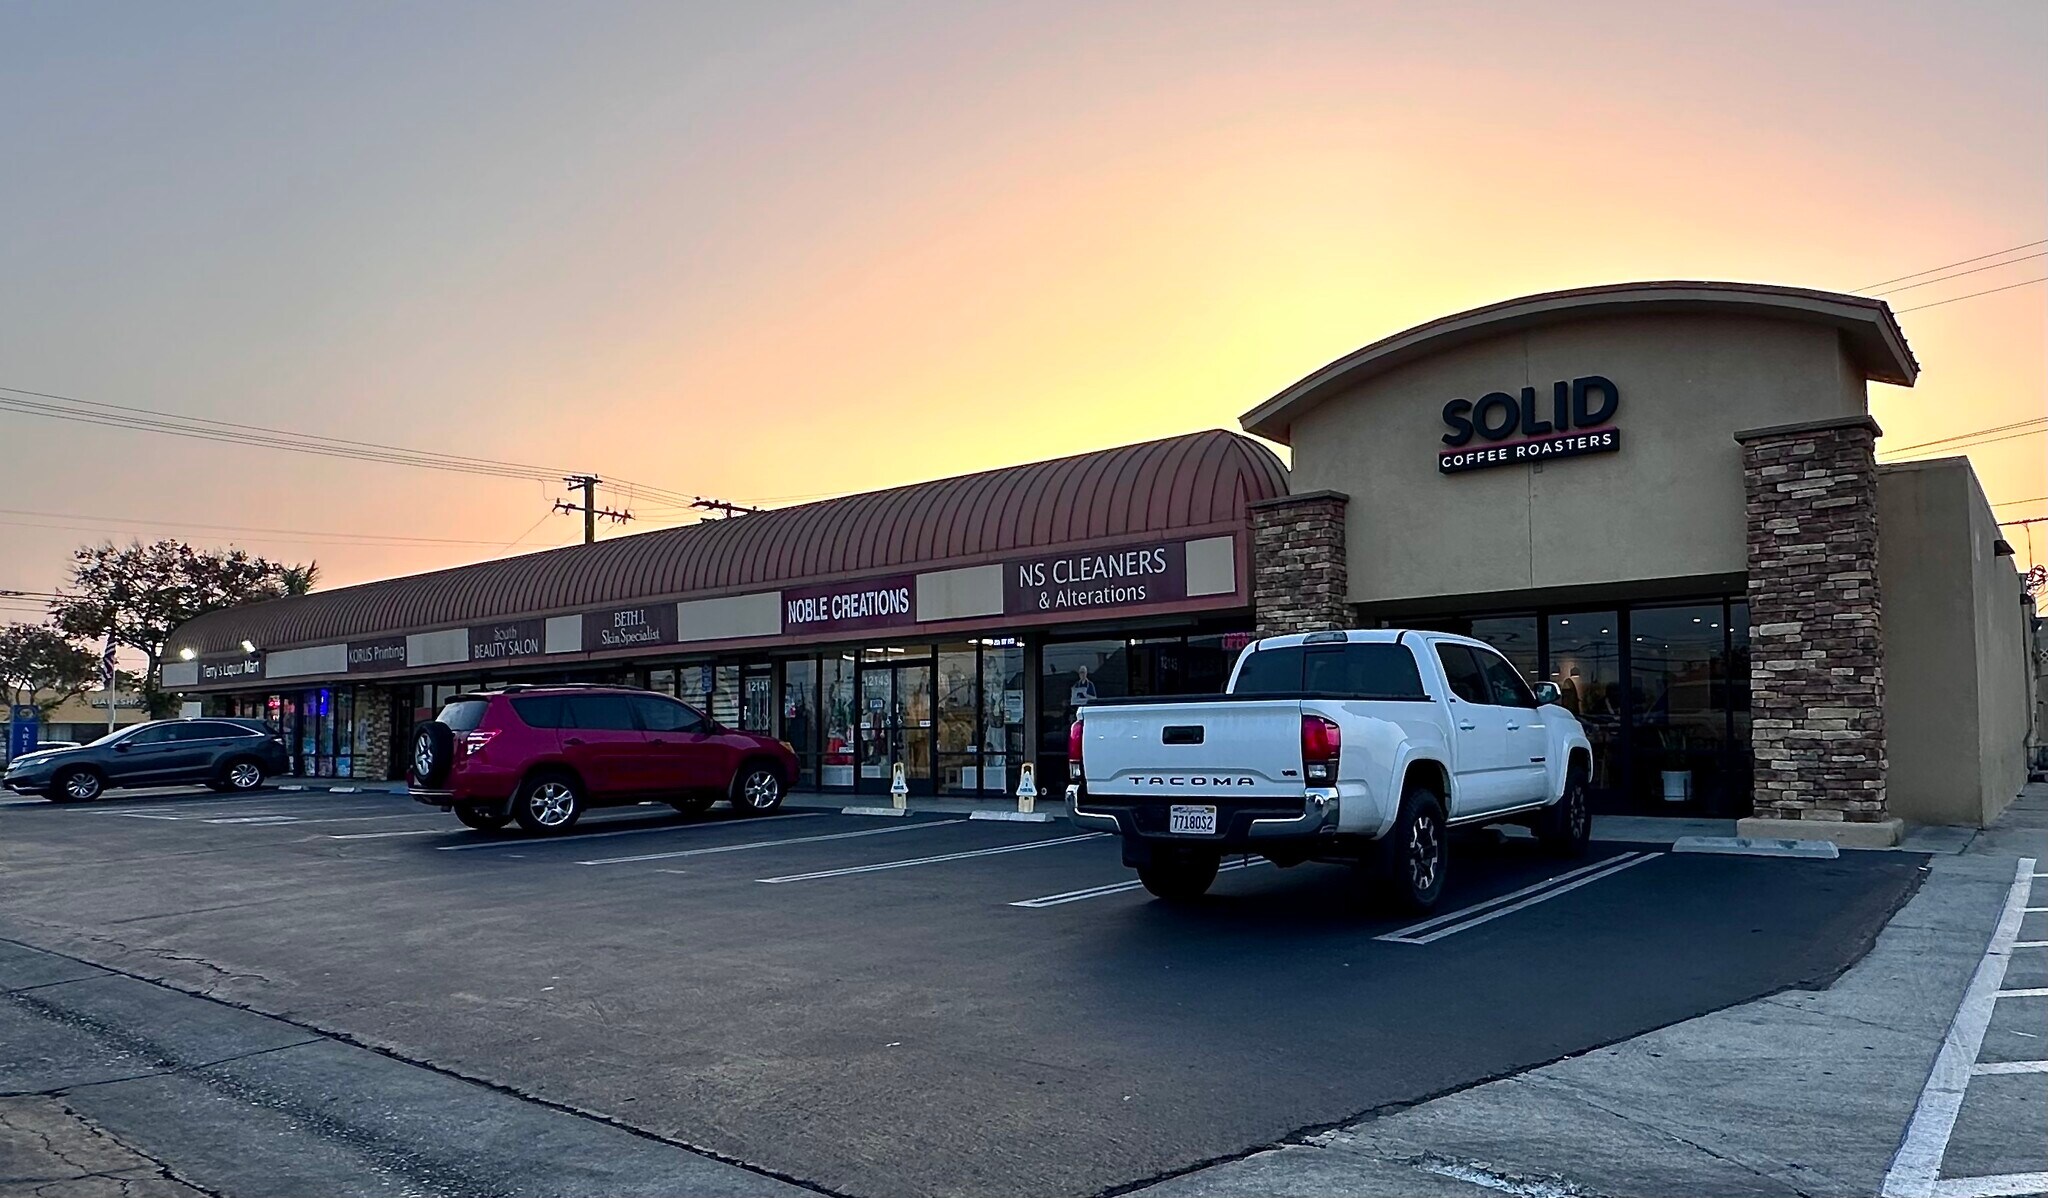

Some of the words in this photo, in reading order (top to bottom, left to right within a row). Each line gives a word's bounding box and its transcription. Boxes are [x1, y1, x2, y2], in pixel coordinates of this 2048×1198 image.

[1441, 375, 1619, 446] SOLID
[1441, 448, 1508, 468] COFFEE
[1516, 433, 1612, 458] ROASTERS
[1019, 562, 1046, 588] NS
[1052, 547, 1167, 584] CLEANERS
[787, 596, 828, 624] NOBLE
[831, 587, 910, 620] CREATIONS
[1038, 591, 1050, 610] &
[1055, 584, 1146, 609] Alterations
[614, 610, 638, 628] BETH
[494, 626, 517, 642] South
[601, 628, 620, 645] Skin
[620, 625, 660, 646] Specialist
[348, 646, 373, 663] KORUS
[374, 644, 405, 661] Printing
[474, 641, 506, 659] BEAUTY
[508, 638, 539, 656] SALON
[202, 663, 223, 679] Terry's
[223, 662, 244, 678] Liquor
[244, 660, 260, 674] Mart
[747, 681, 769, 692] 12141
[864, 675, 889, 687] 12143
[1128, 776, 1255, 786] TACOMA
[1172, 815, 1213, 831] 77180S2
